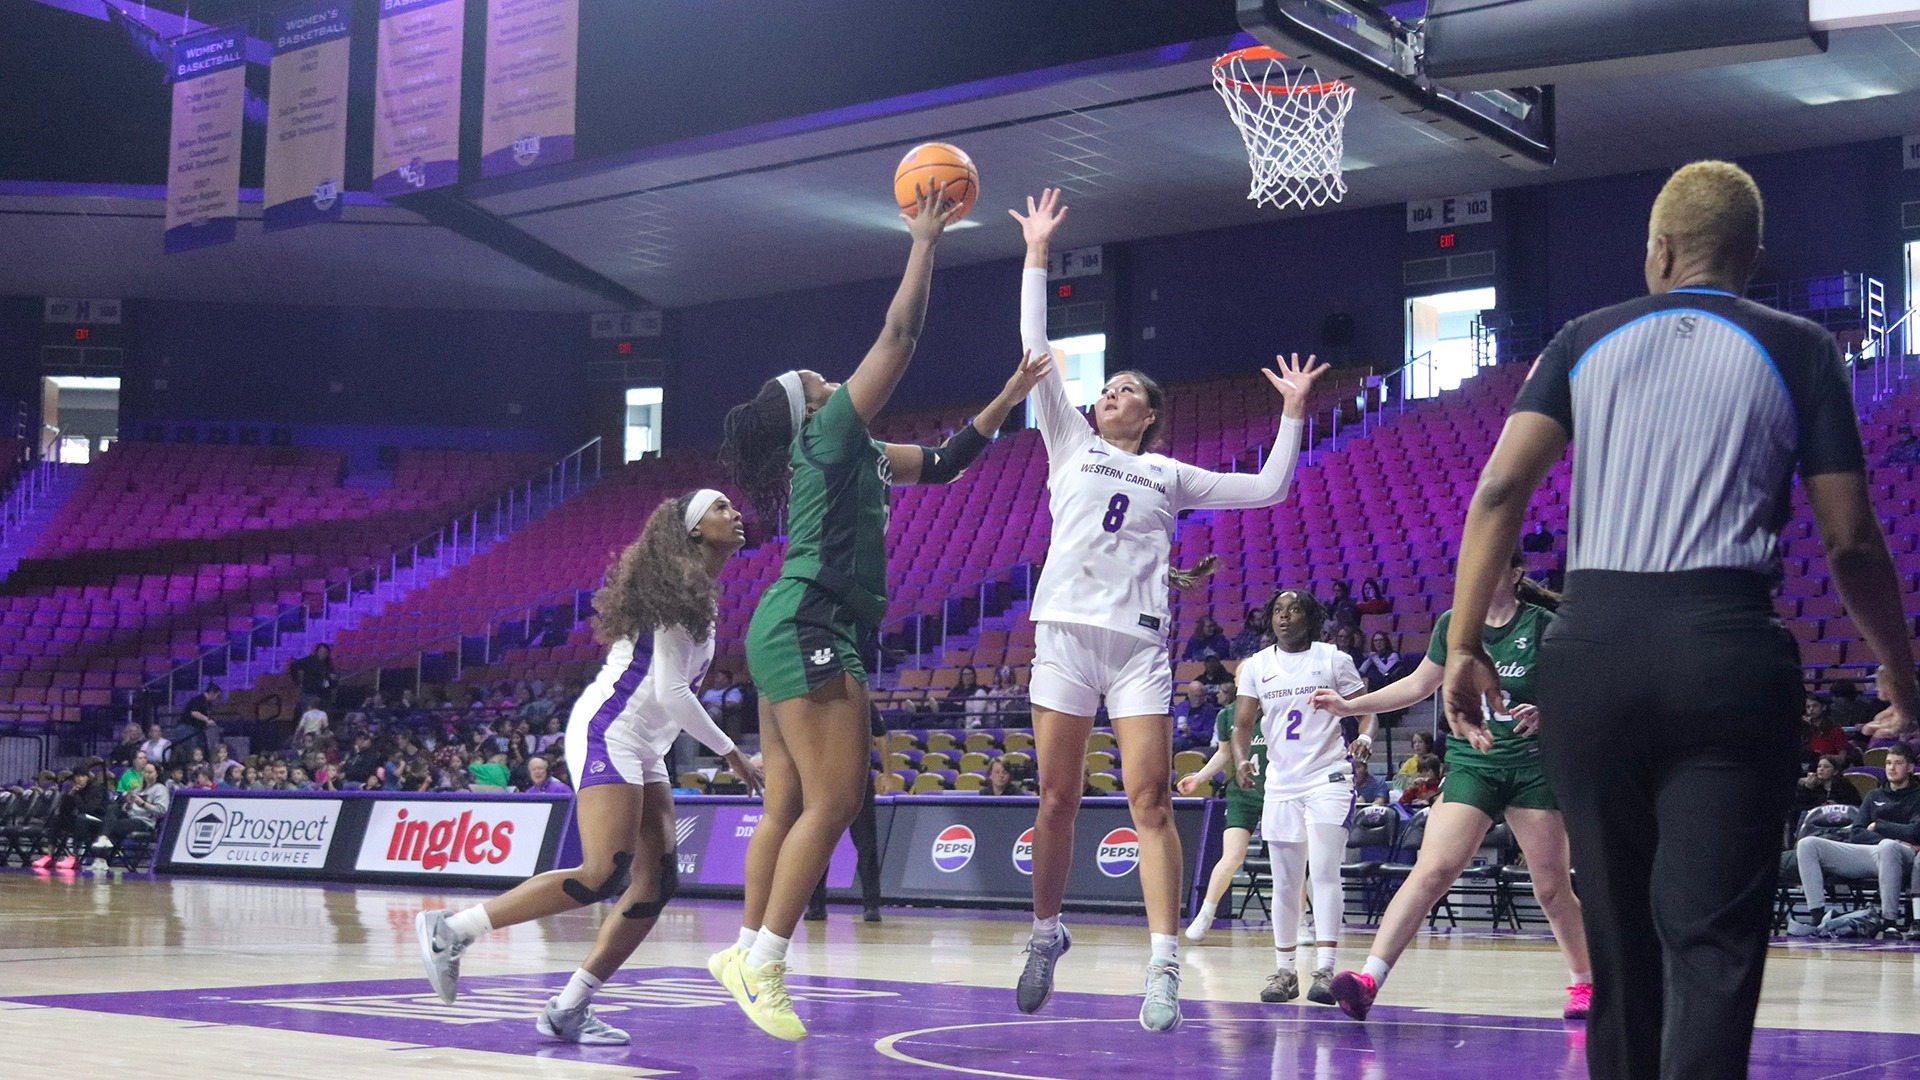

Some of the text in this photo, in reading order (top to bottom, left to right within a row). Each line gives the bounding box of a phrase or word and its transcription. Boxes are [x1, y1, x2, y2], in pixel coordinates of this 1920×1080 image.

[286, 9, 338, 30] WOMEN'S
[279, 23, 346, 48] BASKETBALL
[186, 40, 234, 59] WOMEN'S
[178, 53, 241, 75] BASKETBALL
[399, 165, 425, 187] WCU
[1412, 198, 1488, 225] 104 E 103
[1440, 233, 1455, 248] EXIT
[1061, 252, 1073, 275] F
[1080, 463, 1167, 495] WESTERN CAROLINA
[1102, 492, 1130, 534] 8
[1262, 688, 1293, 700] WESTERN
[1286, 709, 1303, 740] 2
[1821, 804, 1849, 815] WCU
[225, 810, 329, 848] Prospect
[386, 808, 515, 872] ingles
[226, 850, 311, 864] CULLOWHEE
[935, 843, 973, 854] PEPSI
[1100, 846, 1139, 858] PEPSI
